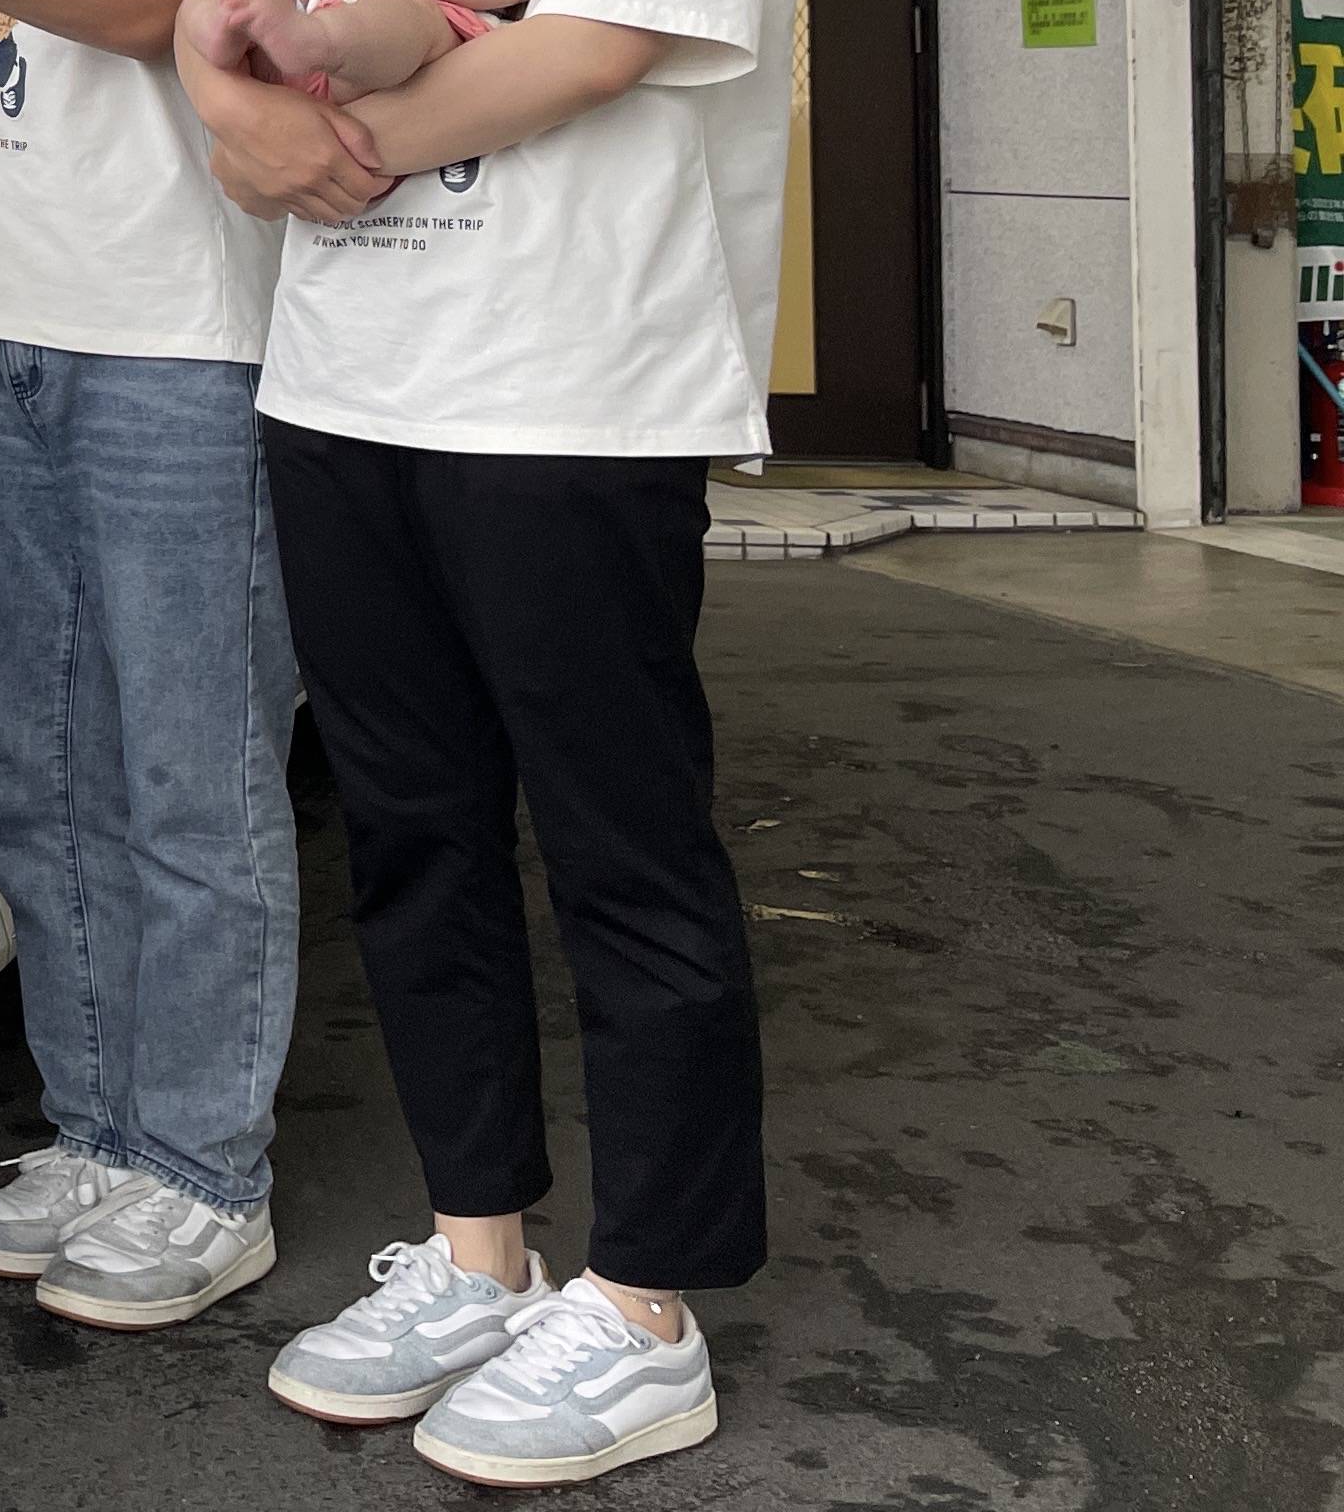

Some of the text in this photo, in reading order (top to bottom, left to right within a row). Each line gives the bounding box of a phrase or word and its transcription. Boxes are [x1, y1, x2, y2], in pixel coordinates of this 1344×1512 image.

[357, 216, 406, 229] SCENERY
[405, 216, 414, 229] IS
[415, 216, 429, 230] ON
[431, 217, 454, 230] THE
[458, 218, 484, 231] TRIP
[350, 235, 370, 247] YOU
[372, 236, 398, 250] WANT
[399, 238, 410, 250] TO
[411, 238, 427, 252] DO
